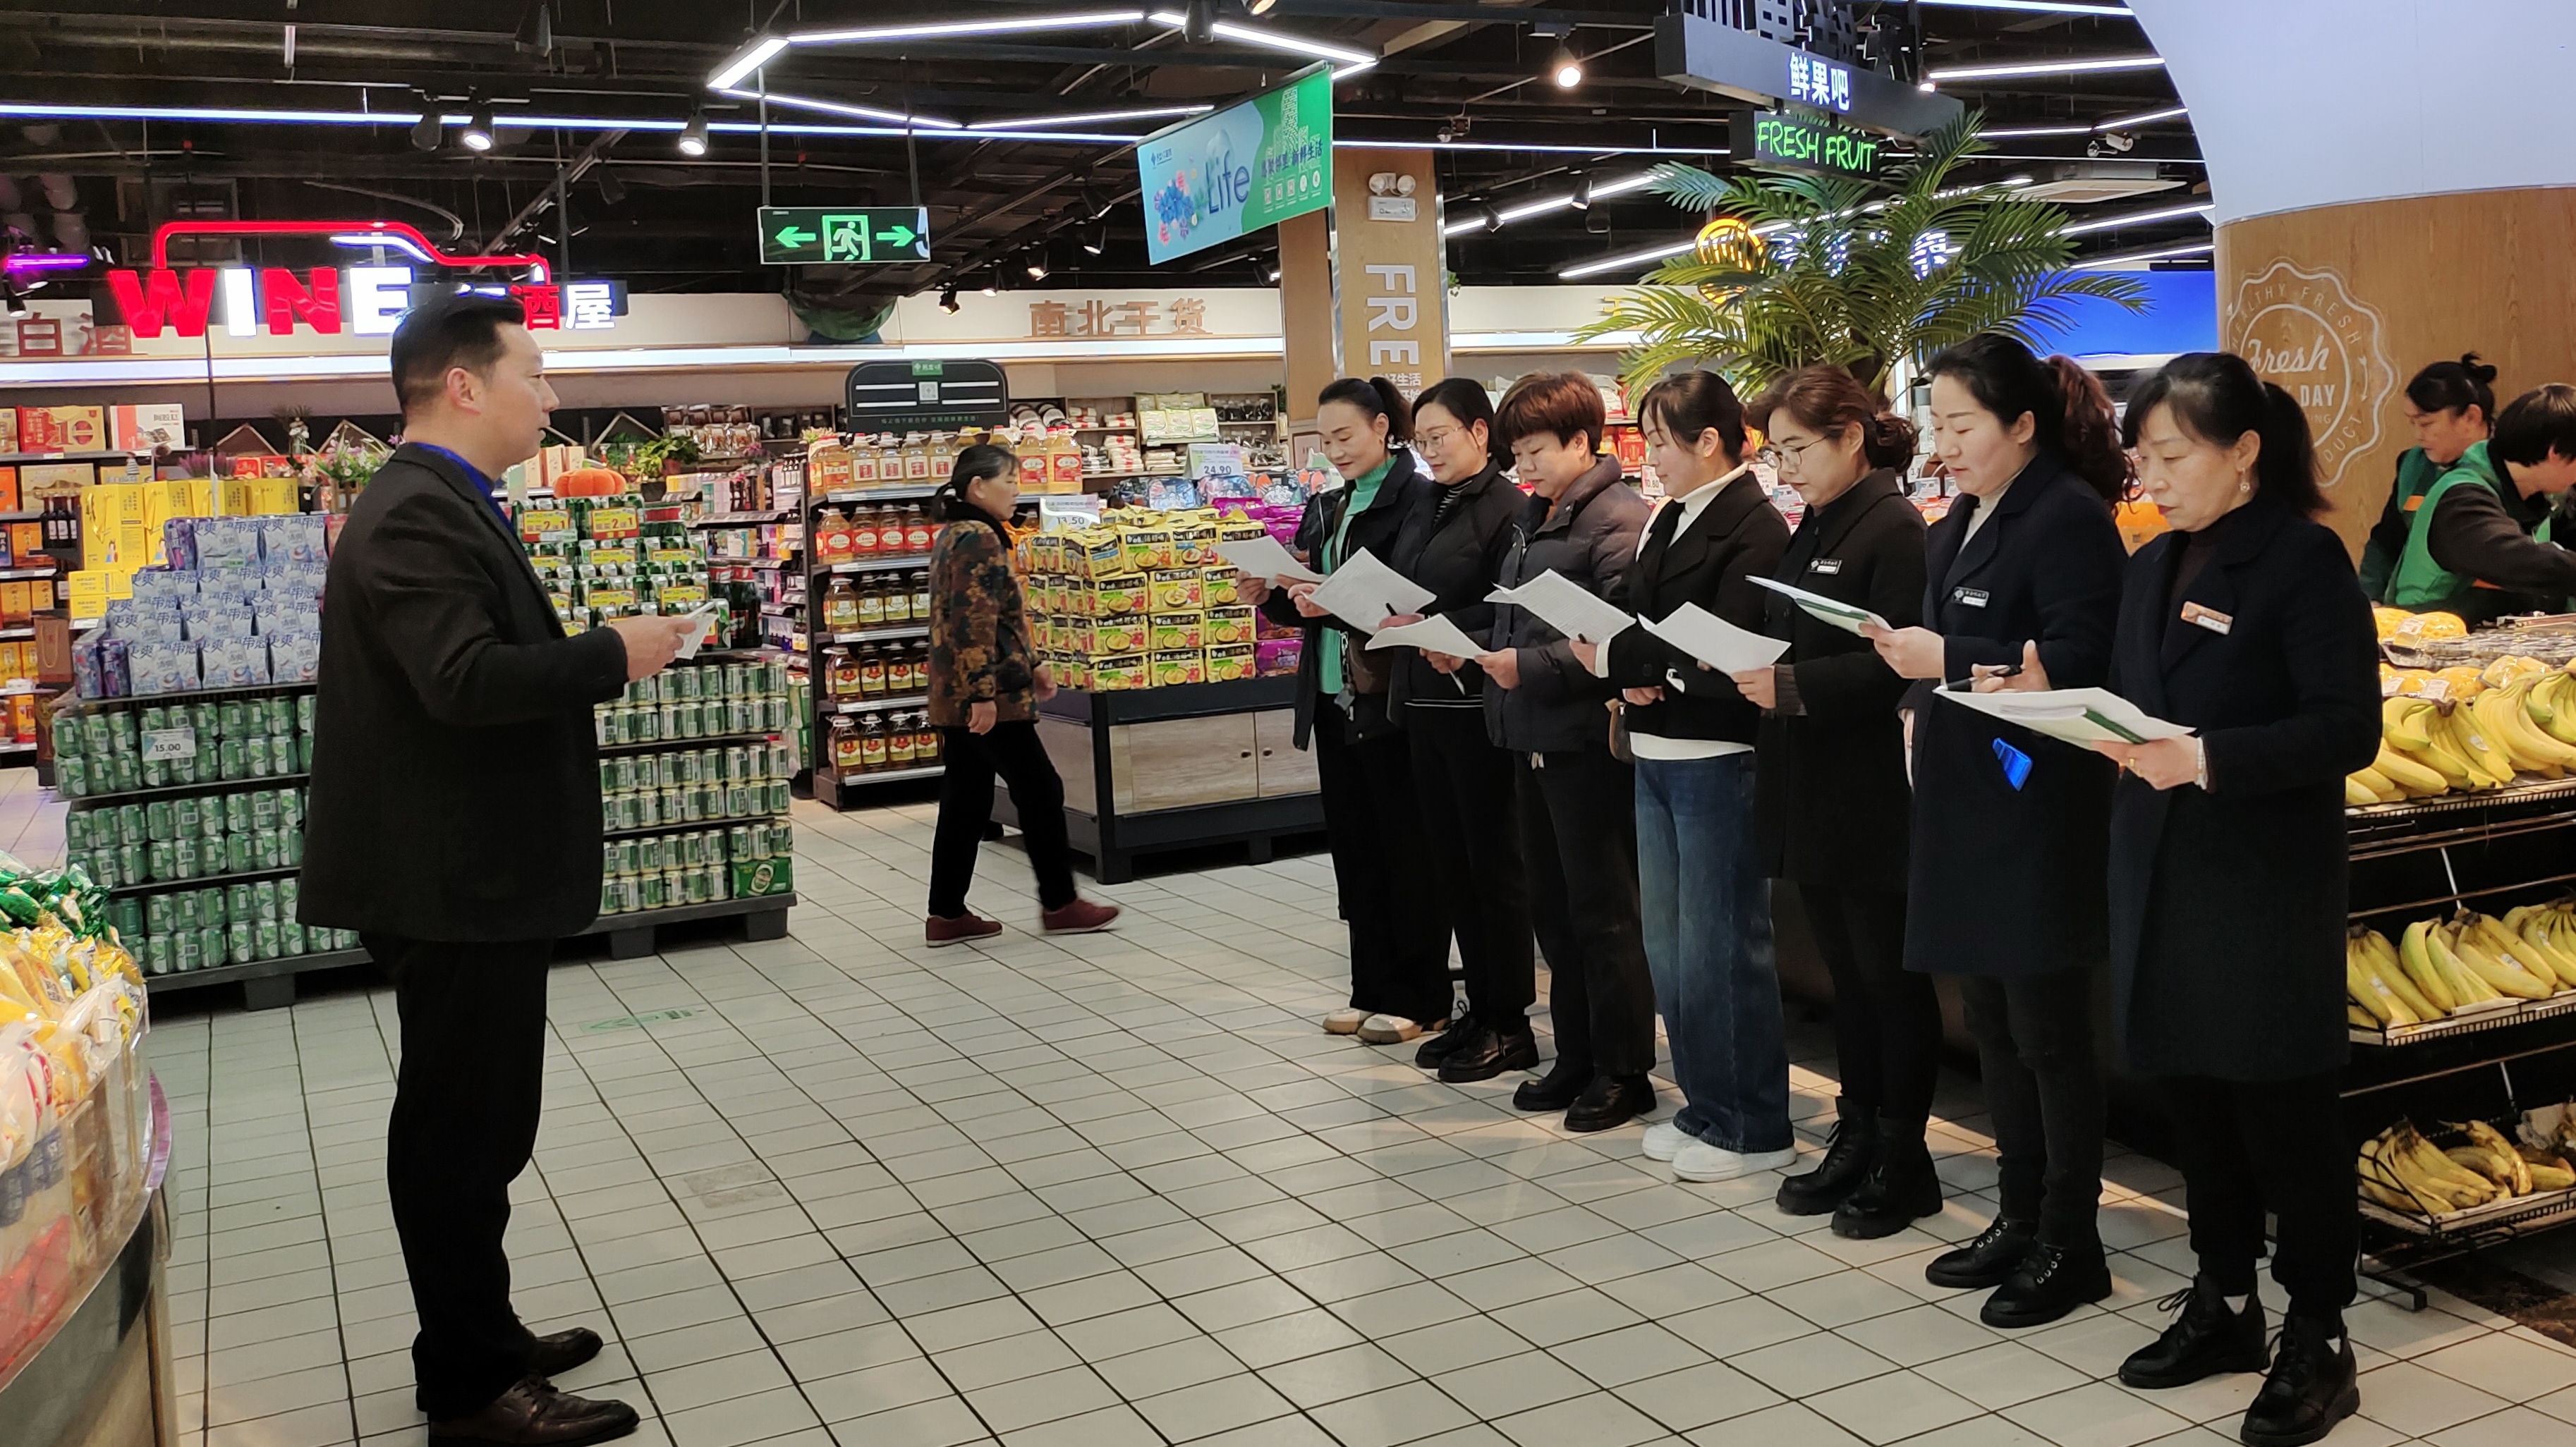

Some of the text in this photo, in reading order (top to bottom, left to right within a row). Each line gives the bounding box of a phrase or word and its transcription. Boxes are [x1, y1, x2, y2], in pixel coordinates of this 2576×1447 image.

[1790, 51, 1850, 111] 鲜果吧
[1756, 121, 1877, 173] FRESH FRUIT
[1205, 149, 1251, 214] Life
[108, 267, 414, 338] WINE
[1029, 298, 1208, 335] 南北干货
[1365, 264, 1420, 365] FRE
[2301, 286, 2361, 344] FRESH
[17, 312, 132, 355] 白酒
[2248, 334, 2330, 374] Fresh
[2299, 384, 2335, 407] DAY
[1203, 465, 1232, 475] 24.90
[154, 743, 181, 752] 15.00
